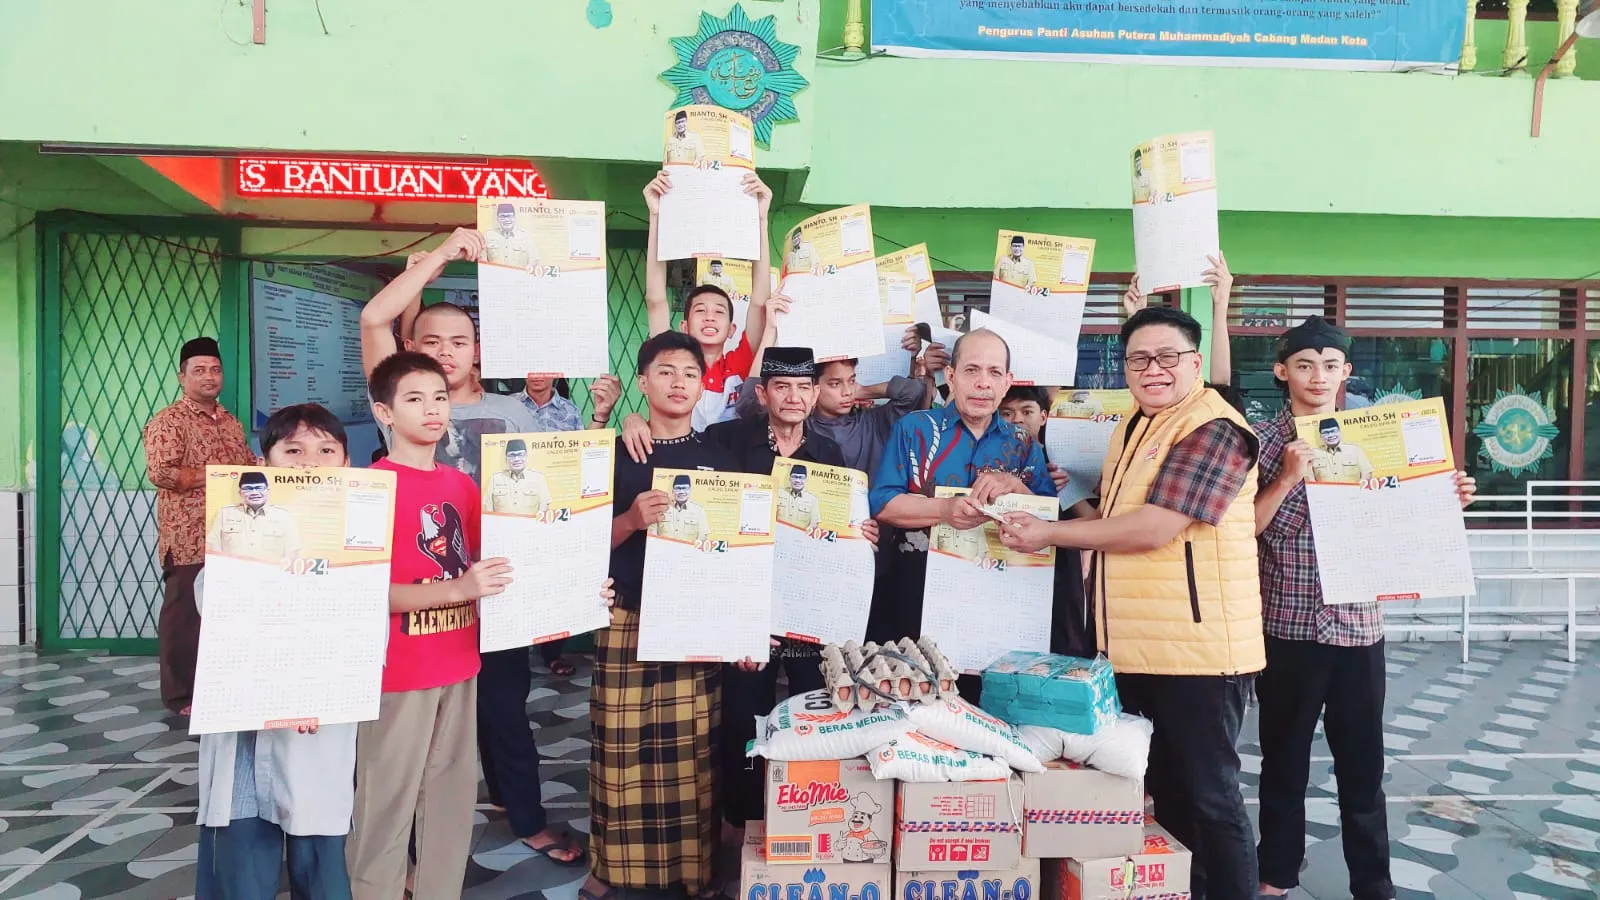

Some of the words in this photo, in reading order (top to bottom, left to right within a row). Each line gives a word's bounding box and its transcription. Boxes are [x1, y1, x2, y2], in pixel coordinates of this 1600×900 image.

[959, 0, 984, 9] yang
[1063, 1, 1082, 11] aku
[1085, 2, 1114, 13] dapat
[1118, 2, 1175, 14] bersedekah
[1179, 4, 1198, 14] dan
[1201, 5, 1250, 16] termasuk
[1253, 8, 1315, 18] orang-orang
[1317, 9, 1342, 19] yang
[978, 25, 1033, 37] Pengurus
[1037, 27, 1067, 38] Panti
[1071, 28, 1114, 39] Asuhan
[1118, 29, 1155, 41] Putera
[1159, 31, 1250, 44] Muhammadiyah
[1254, 32, 1297, 45] Cabang
[1301, 34, 1338, 45] Medan
[1341, 35, 1368, 46] Kota
[718, 112, 728, 120] SH
[284, 164, 443, 195] BANTUAN
[461, 170, 549, 197] YANG
[519, 206, 551, 215] RIANTO,
[554, 207, 565, 215] SH
[1025, 285, 1051, 297] 2024
[1343, 414, 1381, 426] RIANTO,
[1383, 412, 1396, 421] SH
[531, 440, 567, 450] RIANTO,
[568, 439, 579, 448] SH
[274, 475, 324, 486] RIANTO,
[327, 476, 342, 486] SH
[811, 468, 840, 481] RIANTO,
[695, 478, 727, 488] RIANTO,
[729, 480, 740, 488] SH
[1359, 475, 1401, 491] 2024
[536, 507, 572, 524] 2024
[806, 527, 838, 543] 2024
[693, 540, 729, 552] 2024
[280, 558, 330, 575] 2024
[975, 558, 1008, 572] 2024
[819, 721, 854, 734] BERAS
[965, 712, 997, 733] BERAS
[897, 750, 930, 764] BERAS
[776, 781, 848, 806] EkoMie
